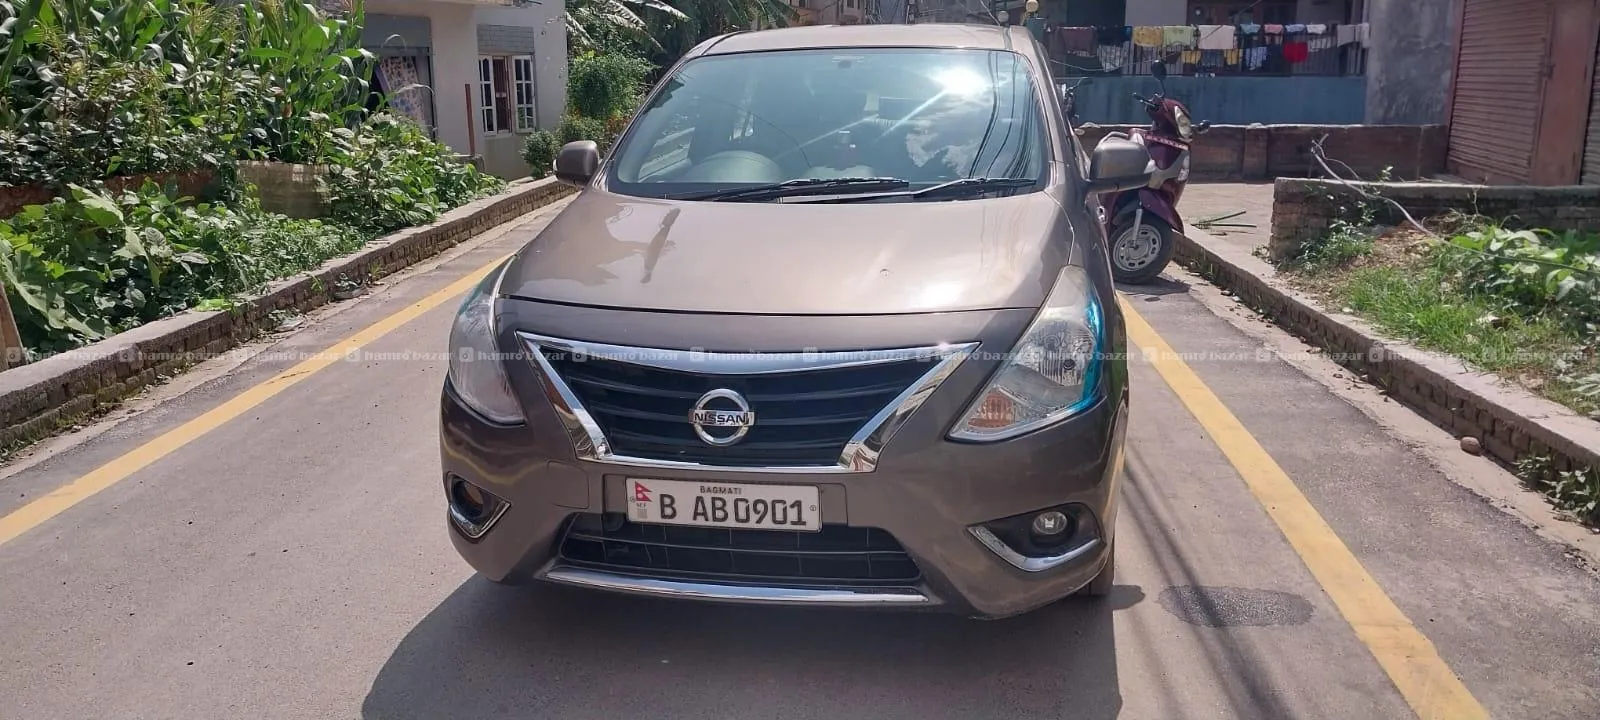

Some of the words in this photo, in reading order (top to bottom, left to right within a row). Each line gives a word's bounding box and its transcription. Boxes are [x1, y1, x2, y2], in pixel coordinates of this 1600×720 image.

[694, 412, 746, 424] NISSAN
[699, 485, 742, 495] BAGMATI
[659, 493, 677, 520] B
